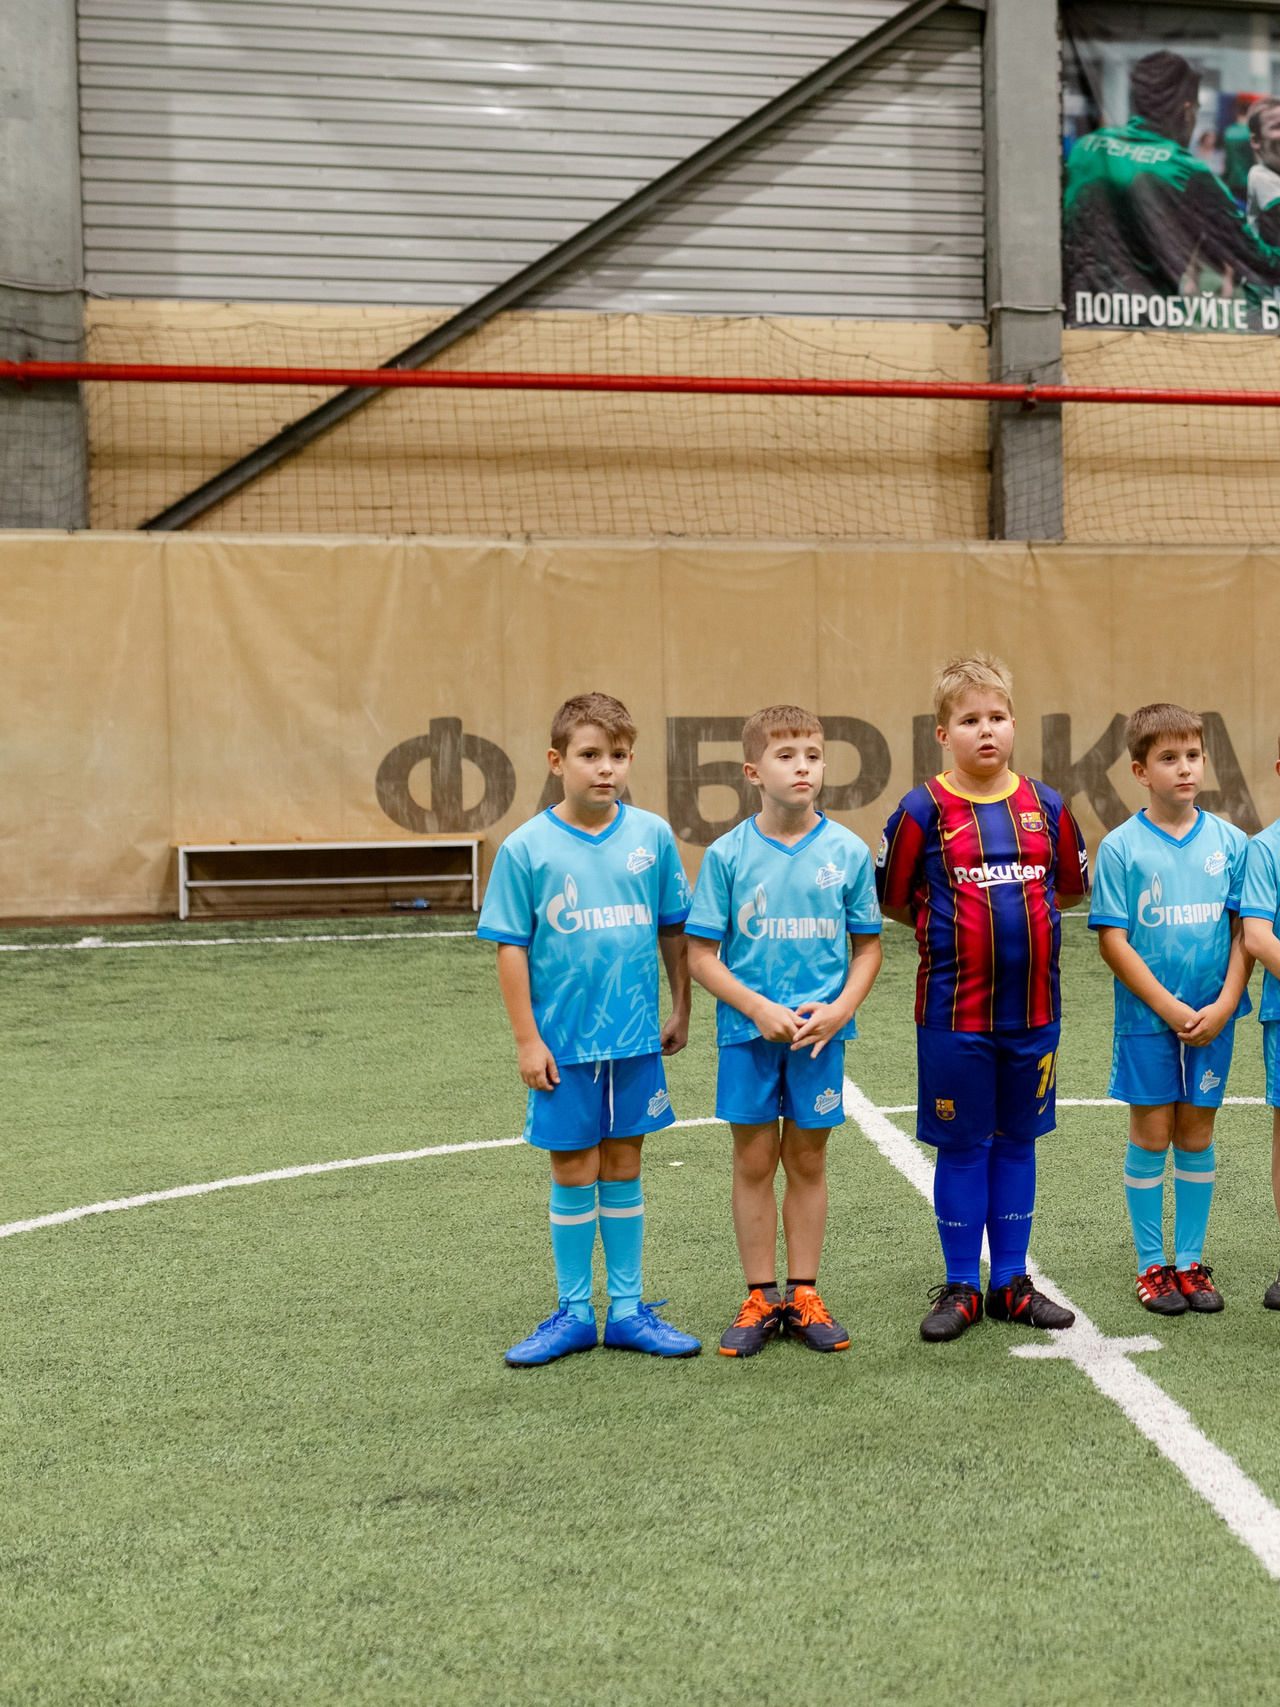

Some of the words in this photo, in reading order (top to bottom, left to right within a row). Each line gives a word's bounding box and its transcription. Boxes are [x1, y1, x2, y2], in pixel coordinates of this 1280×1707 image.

[1083, 134, 1172, 165] ТРЕНЕР
[1075, 290, 1249, 329] ПОПРОБУЙТЕ
[375, 711, 1263, 847] ФБРКА
[953, 861, 1047, 885] Rakuten
[768, 917, 840, 940] ГАЗПРОМ
